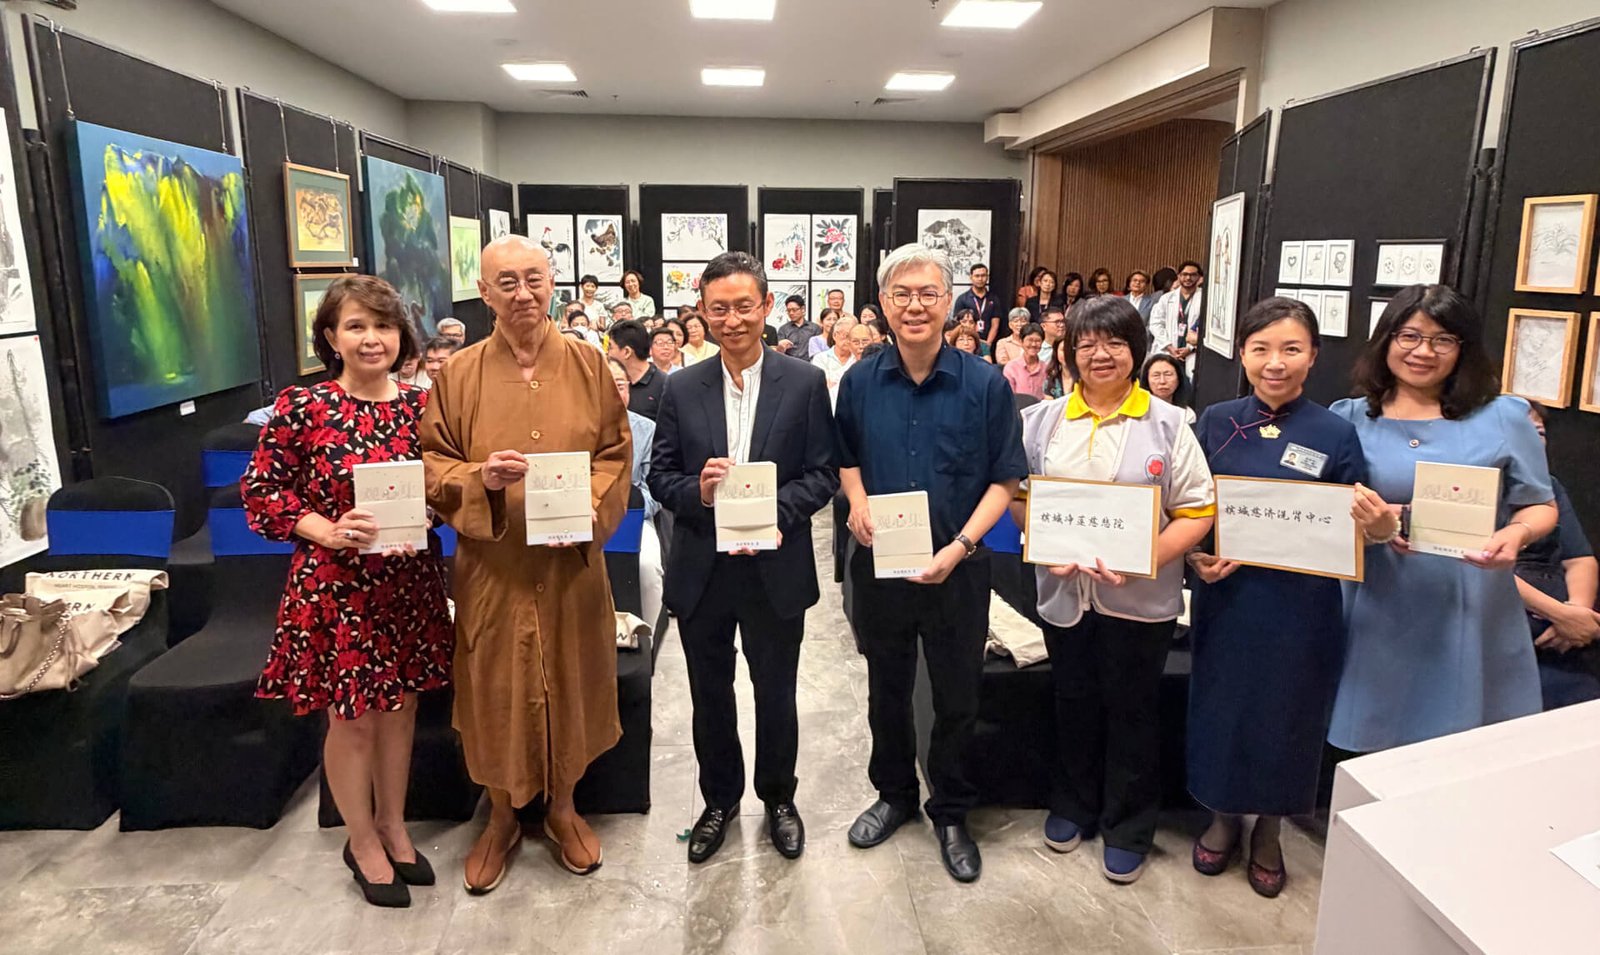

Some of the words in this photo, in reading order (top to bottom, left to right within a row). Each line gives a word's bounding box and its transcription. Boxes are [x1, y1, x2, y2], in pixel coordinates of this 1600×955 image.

[1225, 504, 1332, 524] 槟城慈济洗肾中心
